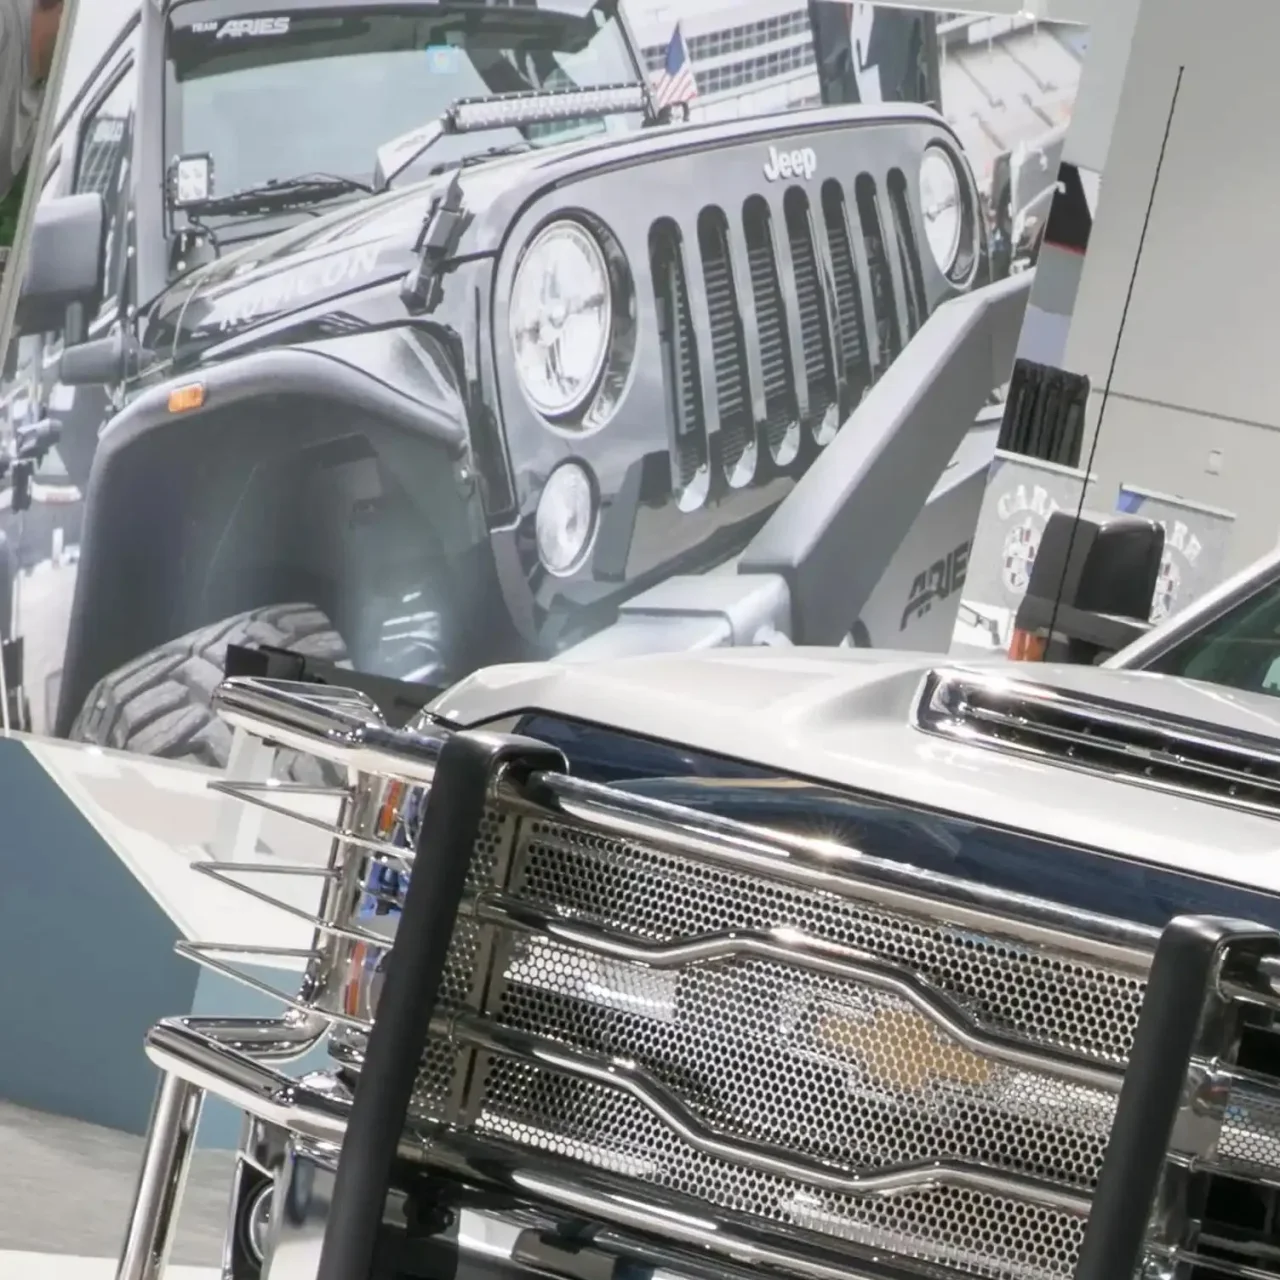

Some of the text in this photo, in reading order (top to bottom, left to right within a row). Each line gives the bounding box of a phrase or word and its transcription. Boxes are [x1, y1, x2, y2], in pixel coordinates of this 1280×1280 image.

[216, 16, 291, 39] ARIES
[763, 145, 817, 180] Jeep
[899, 538, 975, 632] ARIE
